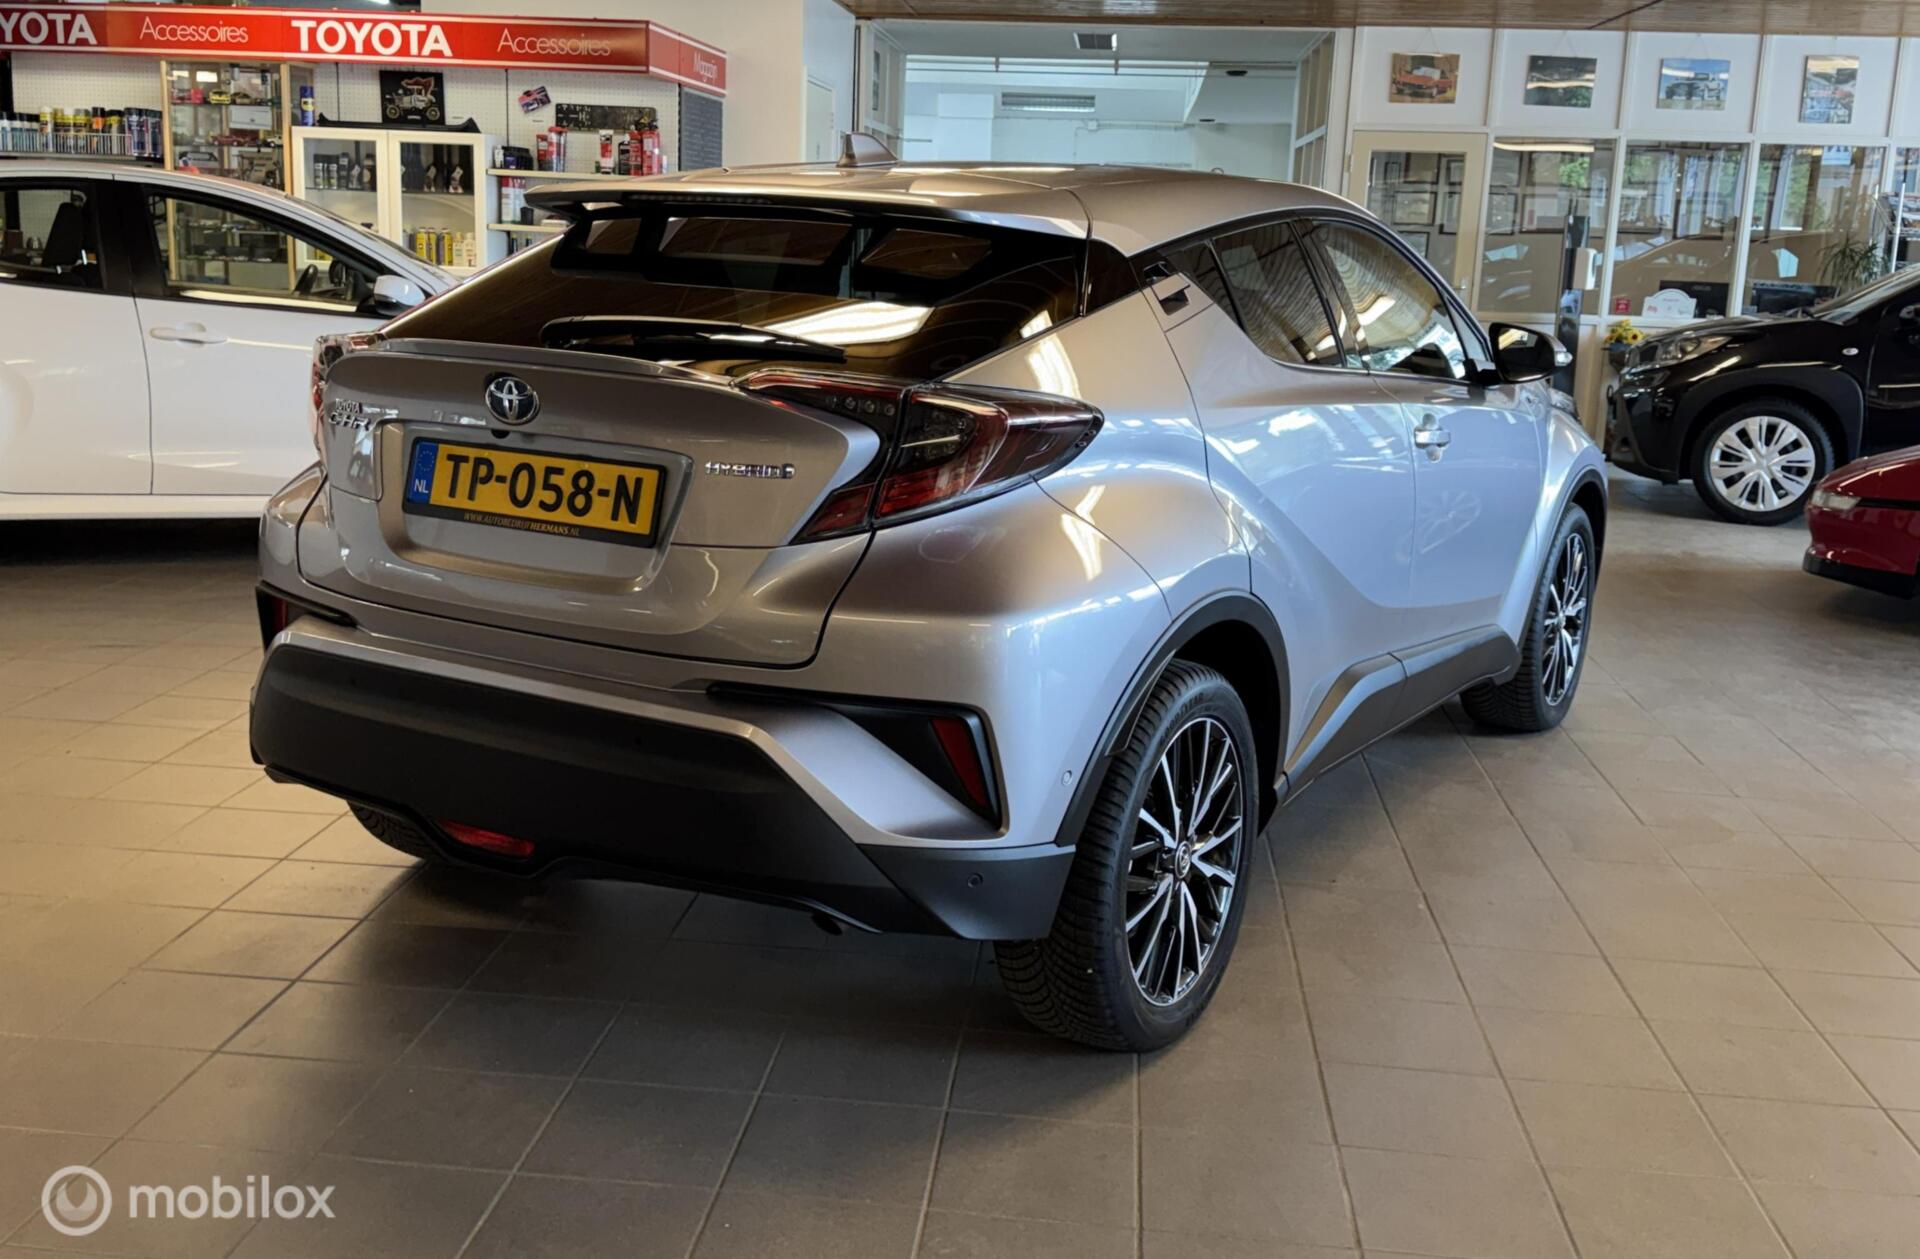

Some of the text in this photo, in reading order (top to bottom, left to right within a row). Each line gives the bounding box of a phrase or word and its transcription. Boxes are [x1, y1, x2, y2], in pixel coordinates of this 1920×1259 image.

[139, 17, 249, 44] Accessoires
[291, 20, 453, 57] TOYOTA
[497, 28, 611, 57] Accessoires
[414, 479, 429, 494] NL
[446, 453, 644, 525] TP-058-N
